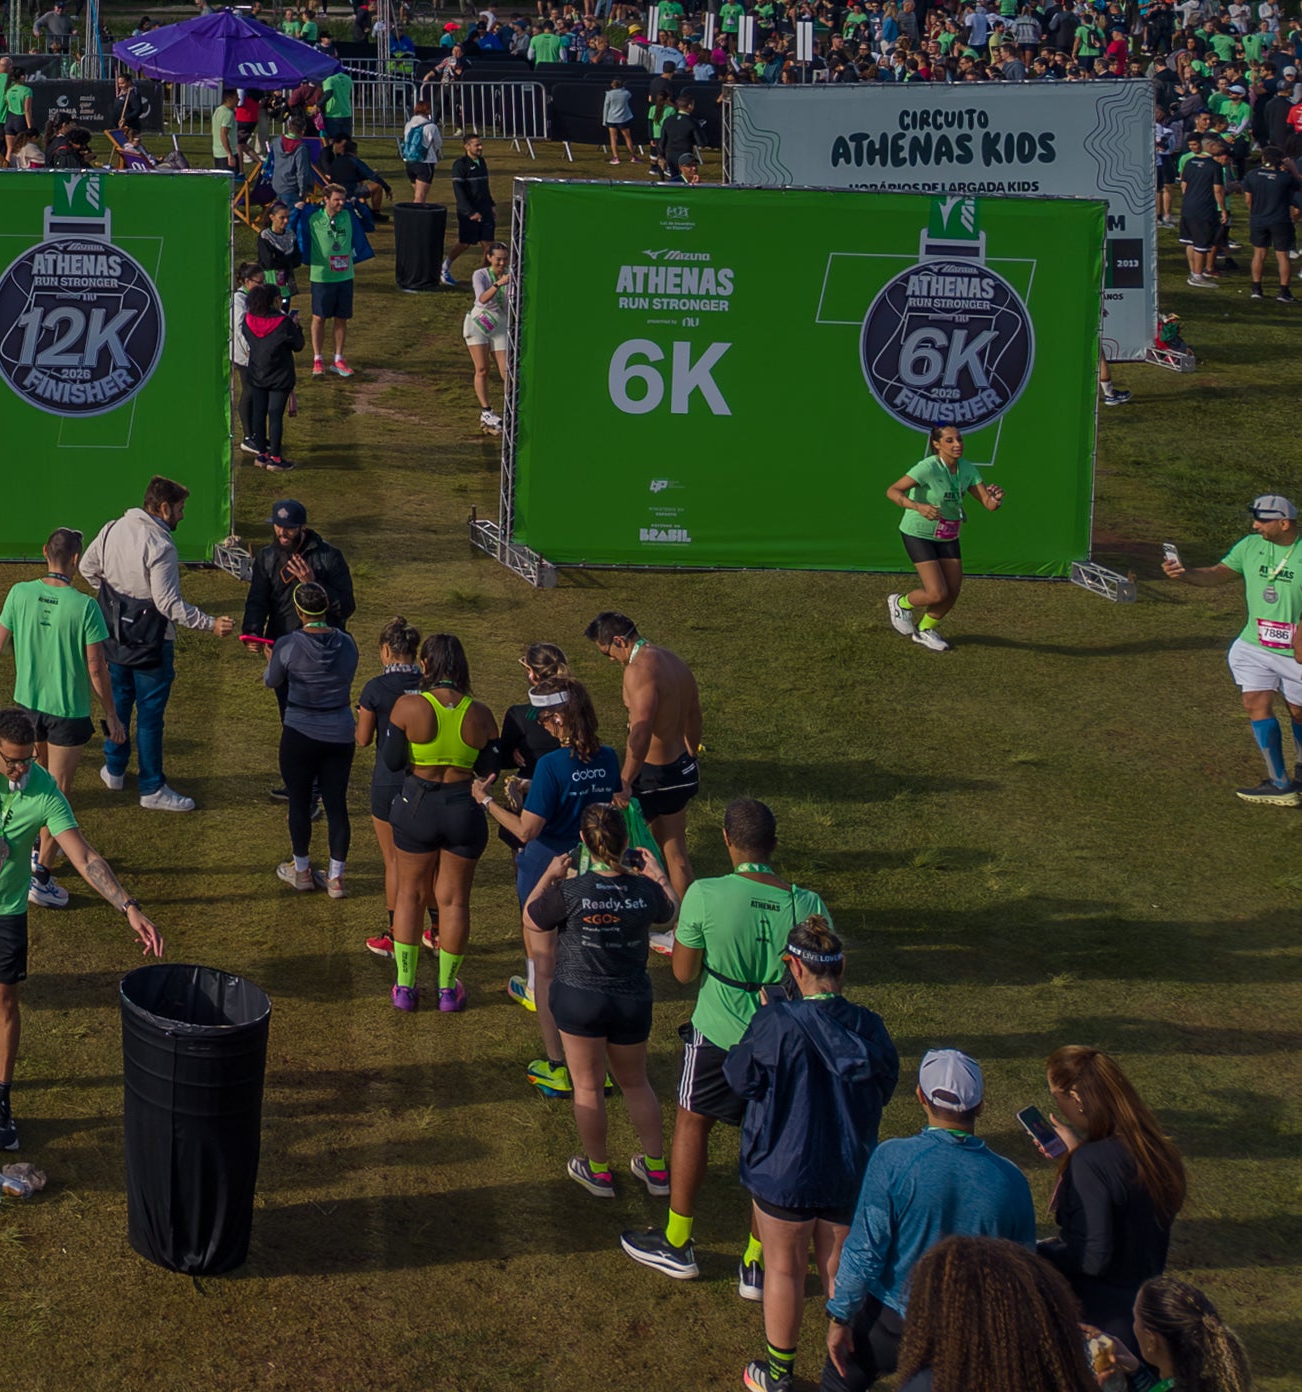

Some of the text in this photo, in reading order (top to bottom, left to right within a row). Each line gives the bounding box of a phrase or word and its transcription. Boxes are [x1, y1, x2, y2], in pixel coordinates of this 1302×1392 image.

[238, 62, 278, 76] nu
[899, 108, 989, 131] CIRCUITO
[831, 132, 1057, 168] ATHENAS KIDS
[1007, 181, 1039, 192] KIDS
[31, 253, 122, 277] ATHENAS
[1117, 259, 1139, 268] 2013
[34, 276, 119, 288] RUN STRONGER
[615, 265, 734, 297] ATHENAS
[906, 275, 995, 299] ATHENAS
[619, 297, 729, 312] RUN STRONGER
[909, 297, 991, 310] RUN STRONGER
[17, 306, 138, 369] 12K
[898, 326, 999, 388] 6K
[62, 368, 91, 379] 2026
[608, 338, 733, 416] 6K
[23, 368, 134, 404] FINISHER
[931, 388, 960, 399] 2026
[893, 387, 1003, 423] FINISHER
[640, 528, 691, 542] BRASIL
[572, 768, 606, 782] dobro
[582, 898, 647, 912] Ready. Set.
